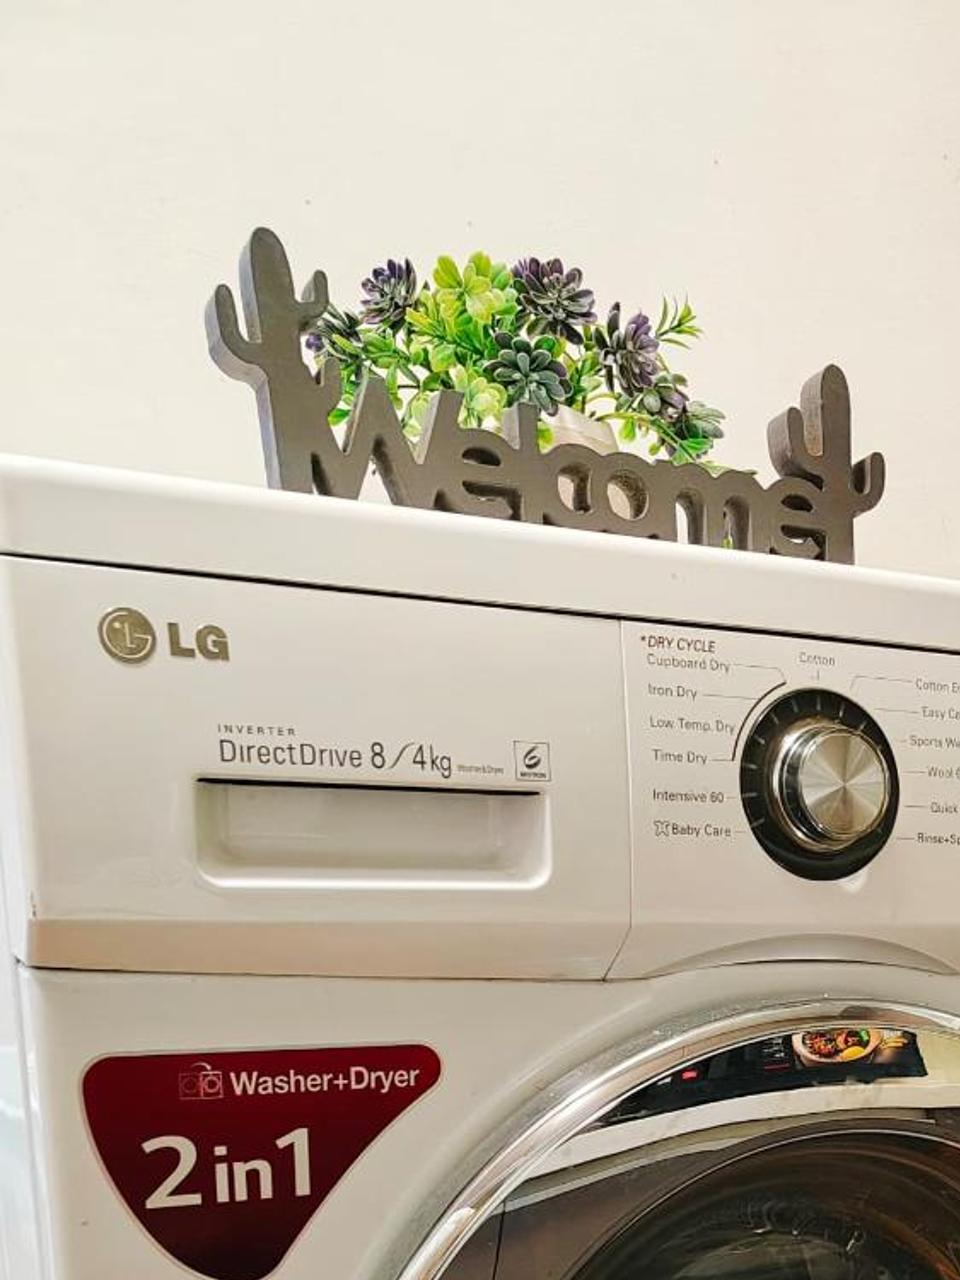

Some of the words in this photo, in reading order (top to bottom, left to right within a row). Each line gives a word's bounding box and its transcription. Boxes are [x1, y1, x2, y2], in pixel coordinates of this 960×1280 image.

[167, 621, 230, 662] LG
[676, 637, 716, 653] CYCLE
[647, 653, 707, 669] Cupboard
[709, 659, 731, 673] Dry
[648, 682, 673, 698] Iron
[676, 686, 697, 700] Dry
[921, 705, 946, 721] Easy
[217, 723, 297, 737] INVERTER
[650, 716, 675, 730] Low
[715, 720, 736, 736] Dry
[909, 734, 943, 748] Sports
[651, 748, 684, 762] Time
[687, 751, 708, 765] Dry
[652, 788, 707, 803] Intensive
[671, 822, 700, 837] Baby
[704, 824, 732, 837] Care
[229, 1066, 420, 1096] Washer+Dryer
[140, 1135, 203, 1210] 2
[213, 1145, 274, 1203] in
[275, 1127, 312, 1197] 1
